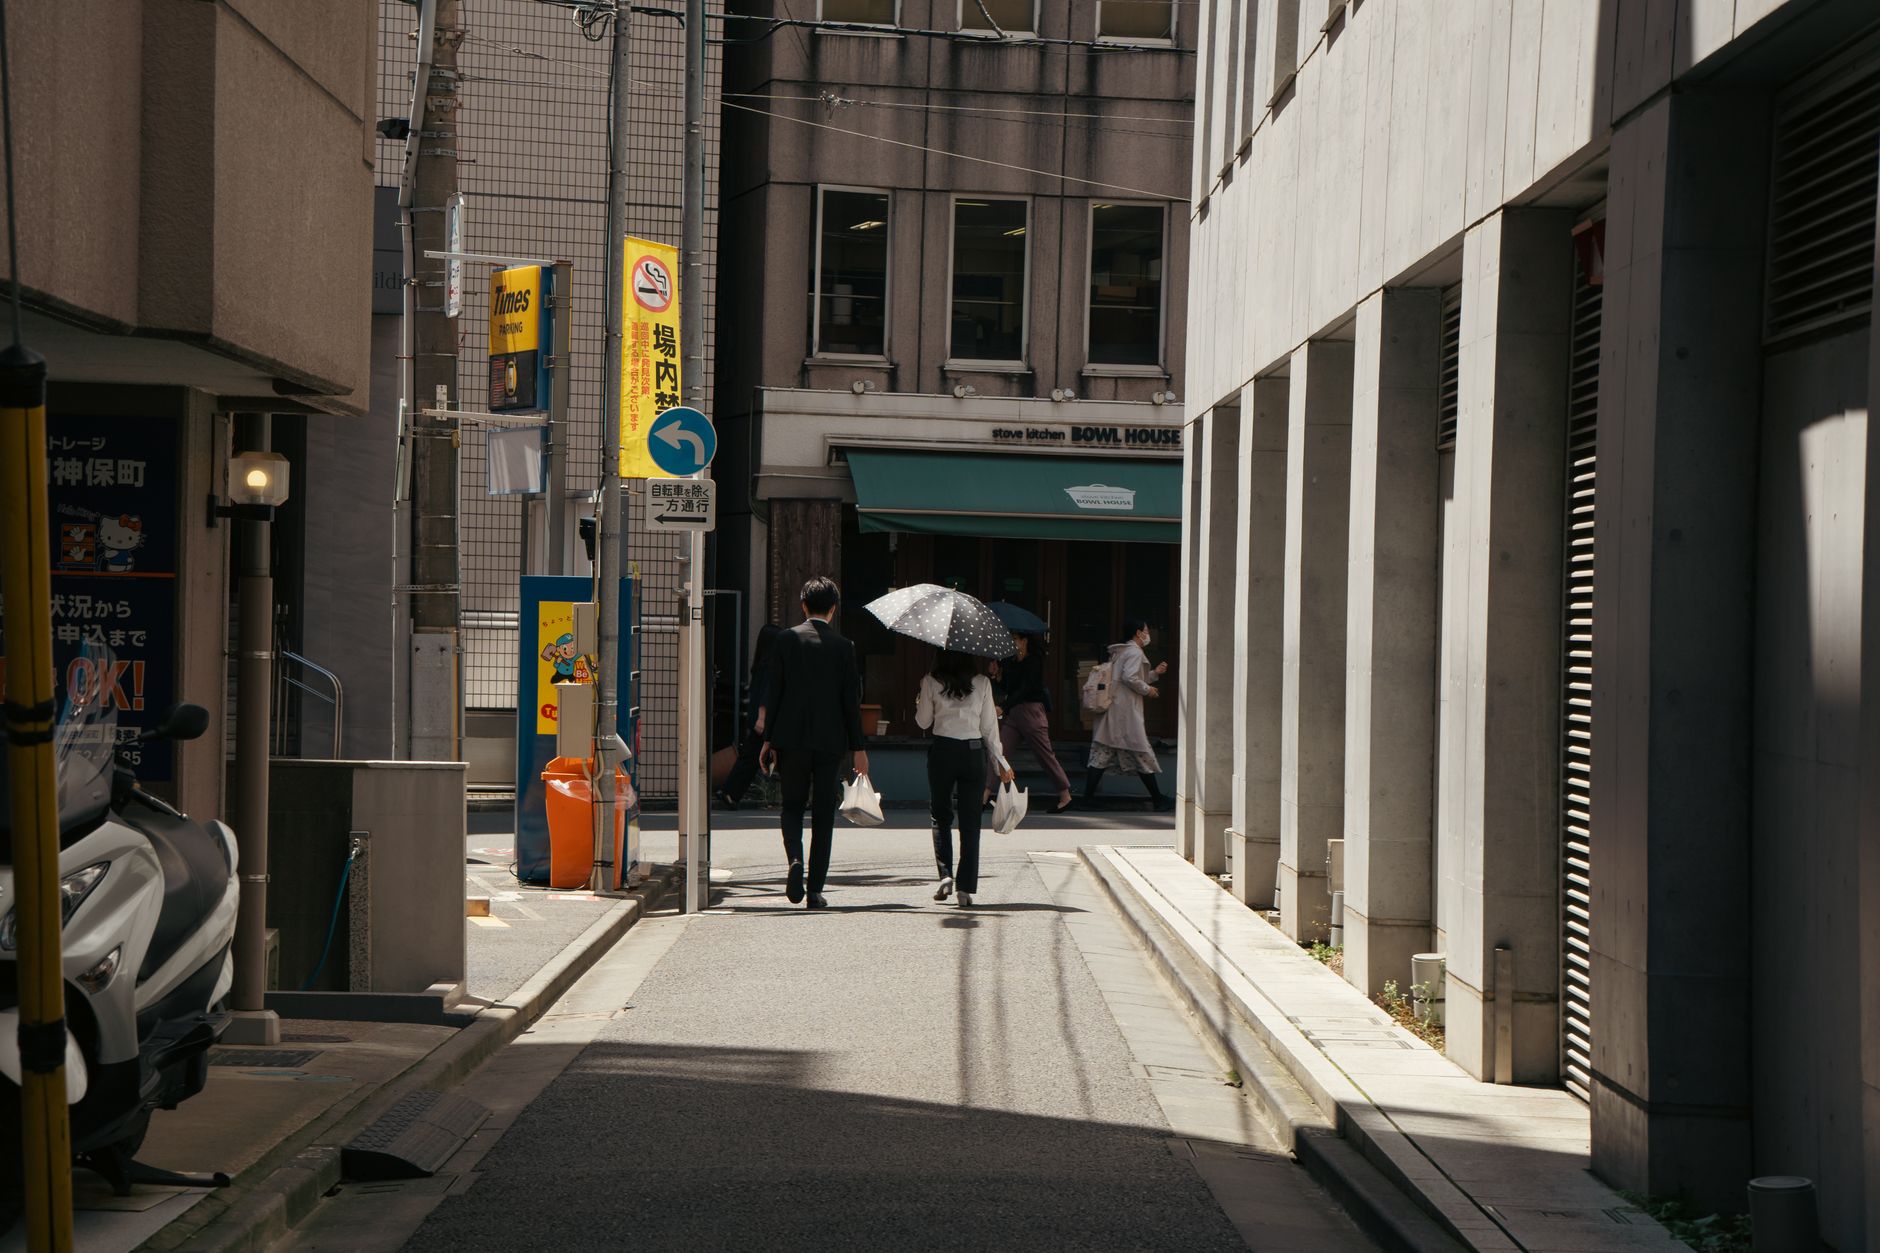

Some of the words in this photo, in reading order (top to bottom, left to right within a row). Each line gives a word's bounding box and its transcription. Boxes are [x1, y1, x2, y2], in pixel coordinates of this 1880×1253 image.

[493, 284, 531, 317] Times
[499, 321, 523, 336] PARKING
[47, 436, 106, 451] トレージ
[992, 428, 1023, 439] stove
[1026, 428, 1065, 440] kitchen
[1071, 426, 1122, 442] BOWL
[1125, 428, 1181, 445] HOUSE
[48, 457, 146, 487] 神保町
[651, 483, 709, 497] 自転車を除く
[651, 499, 709, 513] 一方通行
[52, 623, 147, 648] 申込まで
[67, 657, 145, 711] OK!
